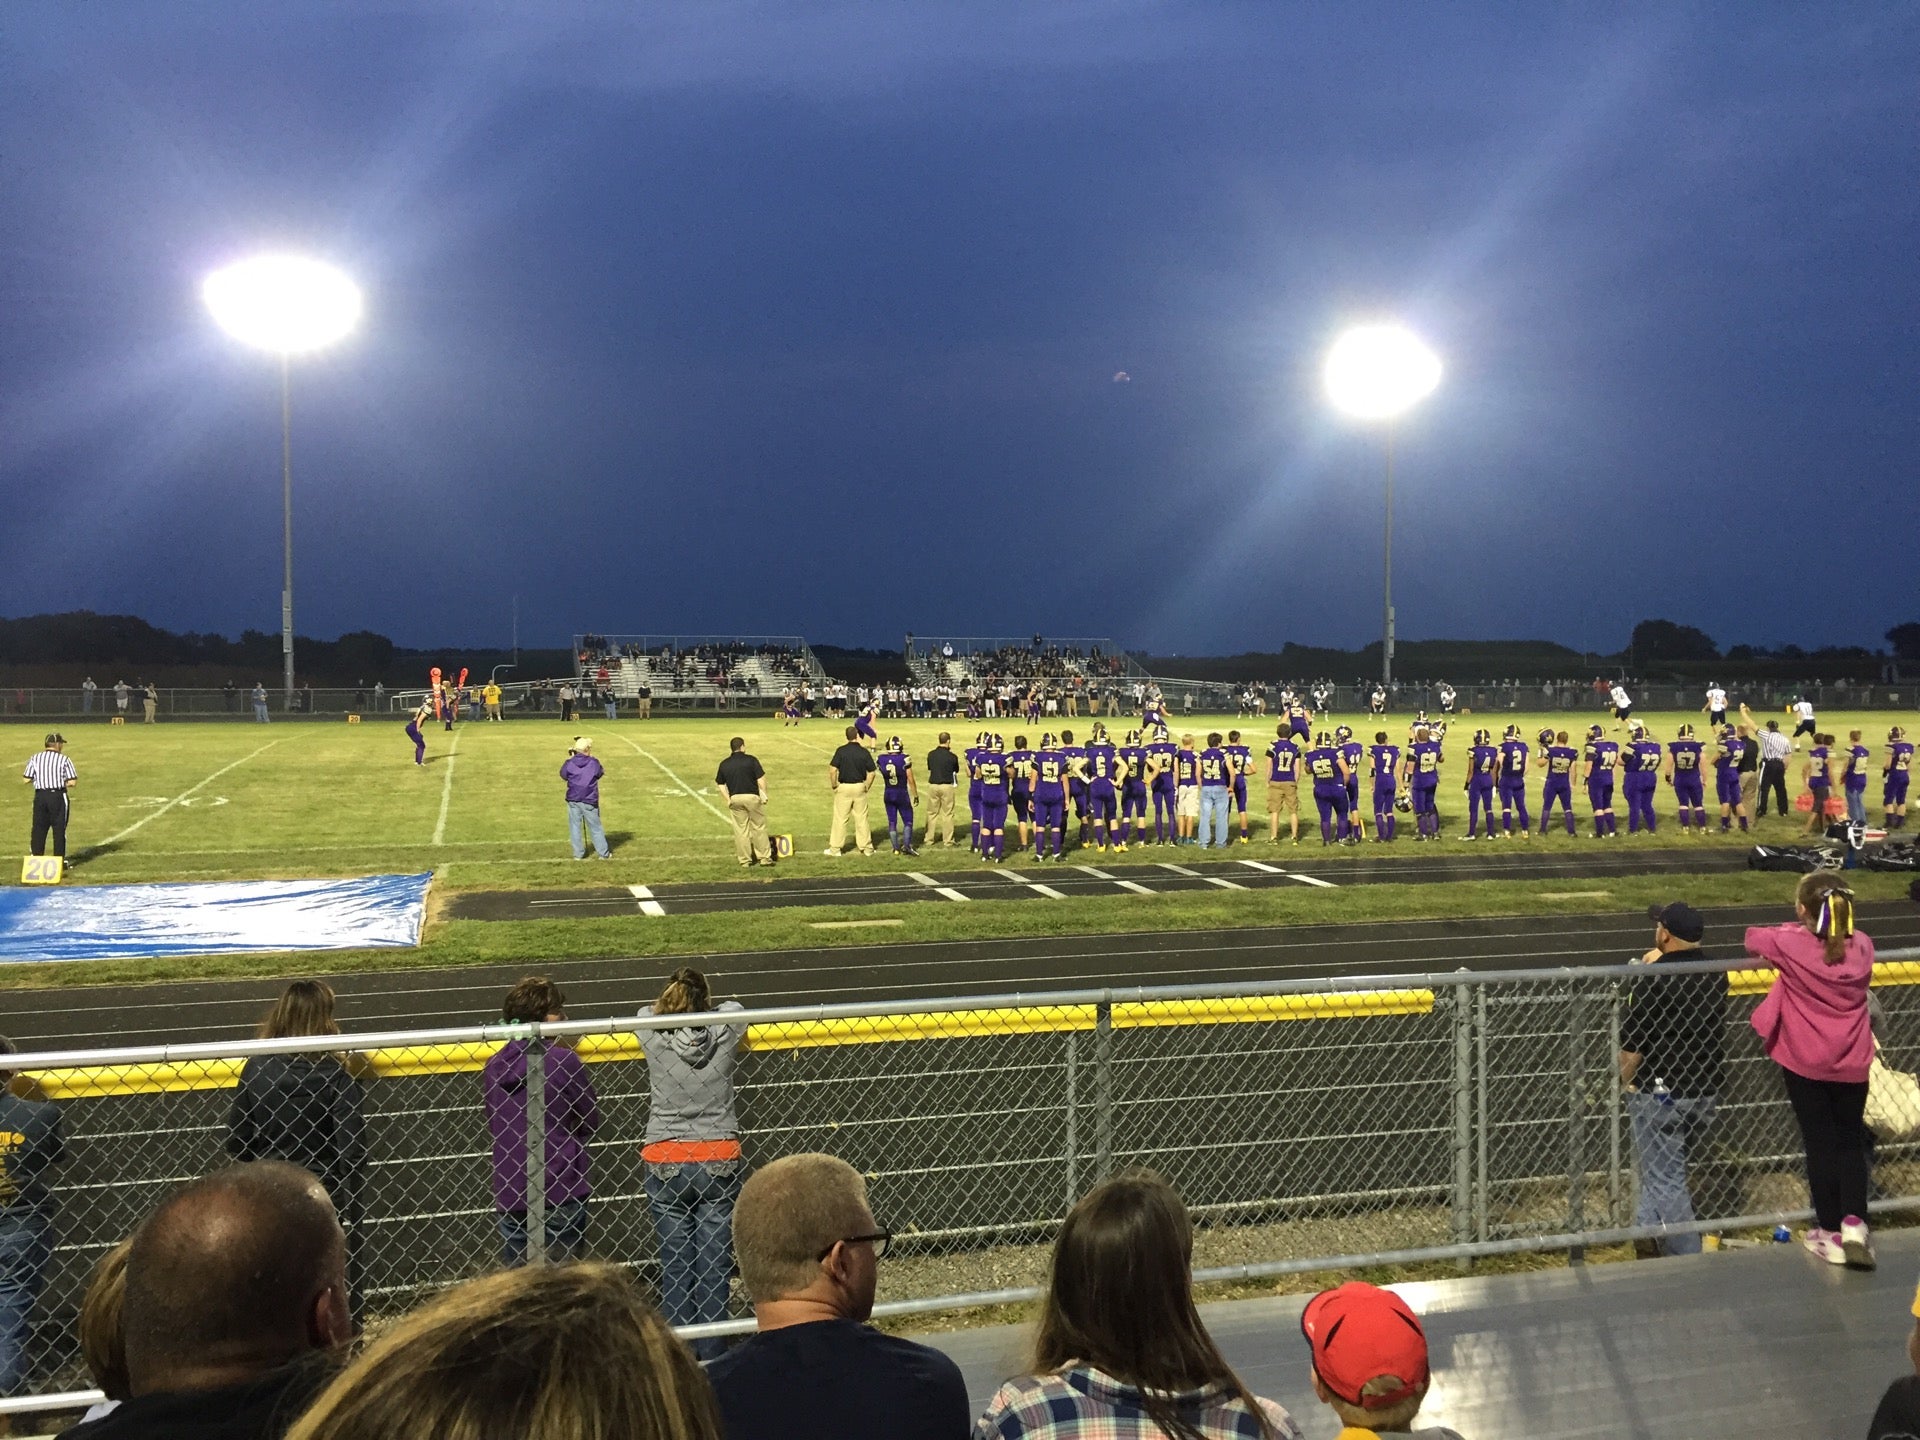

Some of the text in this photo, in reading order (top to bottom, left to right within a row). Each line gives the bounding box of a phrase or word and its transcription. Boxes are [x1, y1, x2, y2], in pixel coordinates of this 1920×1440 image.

[350, 715, 360, 724] 20
[1128, 755, 1138, 778] 5
[1480, 756, 1491, 774] 4
[1512, 750, 1522, 771] 2
[886, 764, 898, 786] 3
[25, 858, 58, 882] 20
